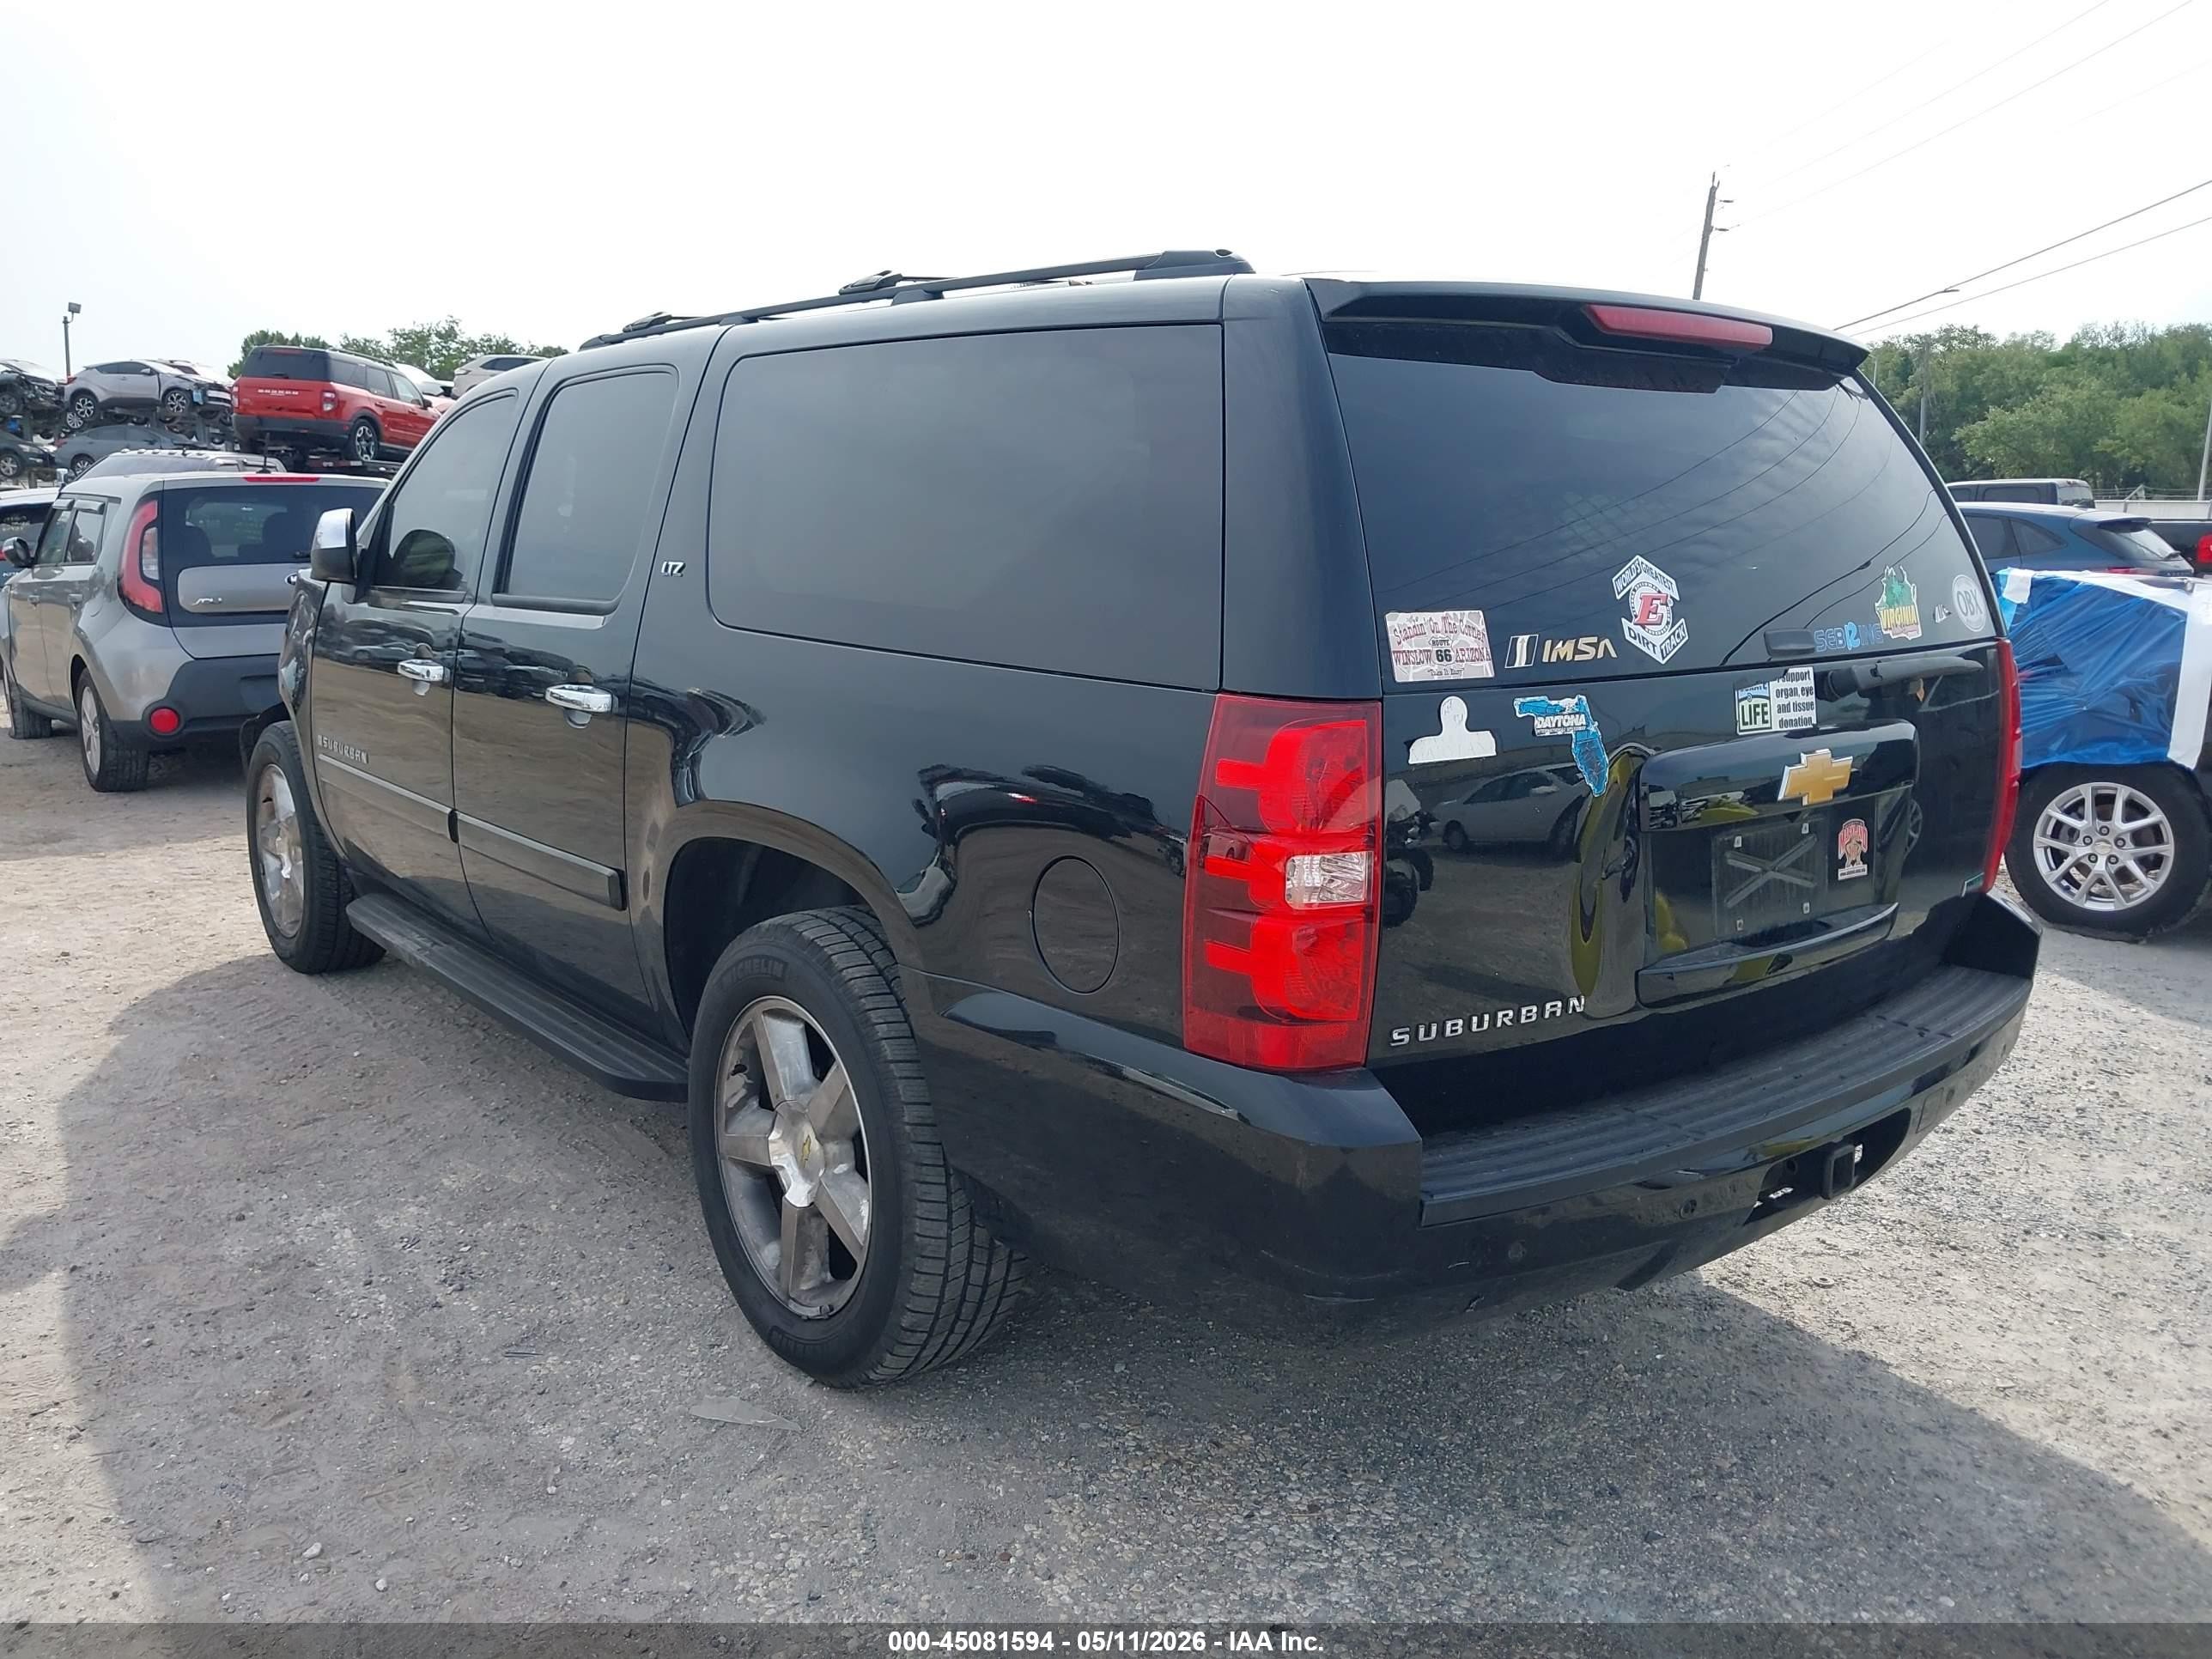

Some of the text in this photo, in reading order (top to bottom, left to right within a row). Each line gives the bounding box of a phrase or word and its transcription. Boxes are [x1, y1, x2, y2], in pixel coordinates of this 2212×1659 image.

[661, 561, 685, 576] LTZ
[1615, 560, 1675, 593] WORLD'S GREATEST
[1633, 592, 1669, 626] E
[1957, 590, 1983, 617] OBX
[1429, 617, 1441, 635] On
[1443, 616, 1458, 635] The
[1460, 618, 1486, 643] Corner
[1879, 605, 1917, 630] VIRGINIA
[1541, 636, 1618, 662] IMSA
[1627, 623, 1686, 659] DIRT TRACK
[1814, 622, 1884, 652] SEBRING
[1392, 648, 1432, 665] WINSLOW
[1435, 648, 1453, 663] 66
[1455, 647, 1492, 664] ARIZONA
[1801, 685, 1814, 697] eye
[1741, 702, 1769, 726] LIFE
[1777, 701, 1814, 714] and tissue
[1535, 714, 1586, 728] DAYTONA
[323, 736, 368, 764] SUBURBAN
[1390, 994, 1586, 1047] SUBURBAN
